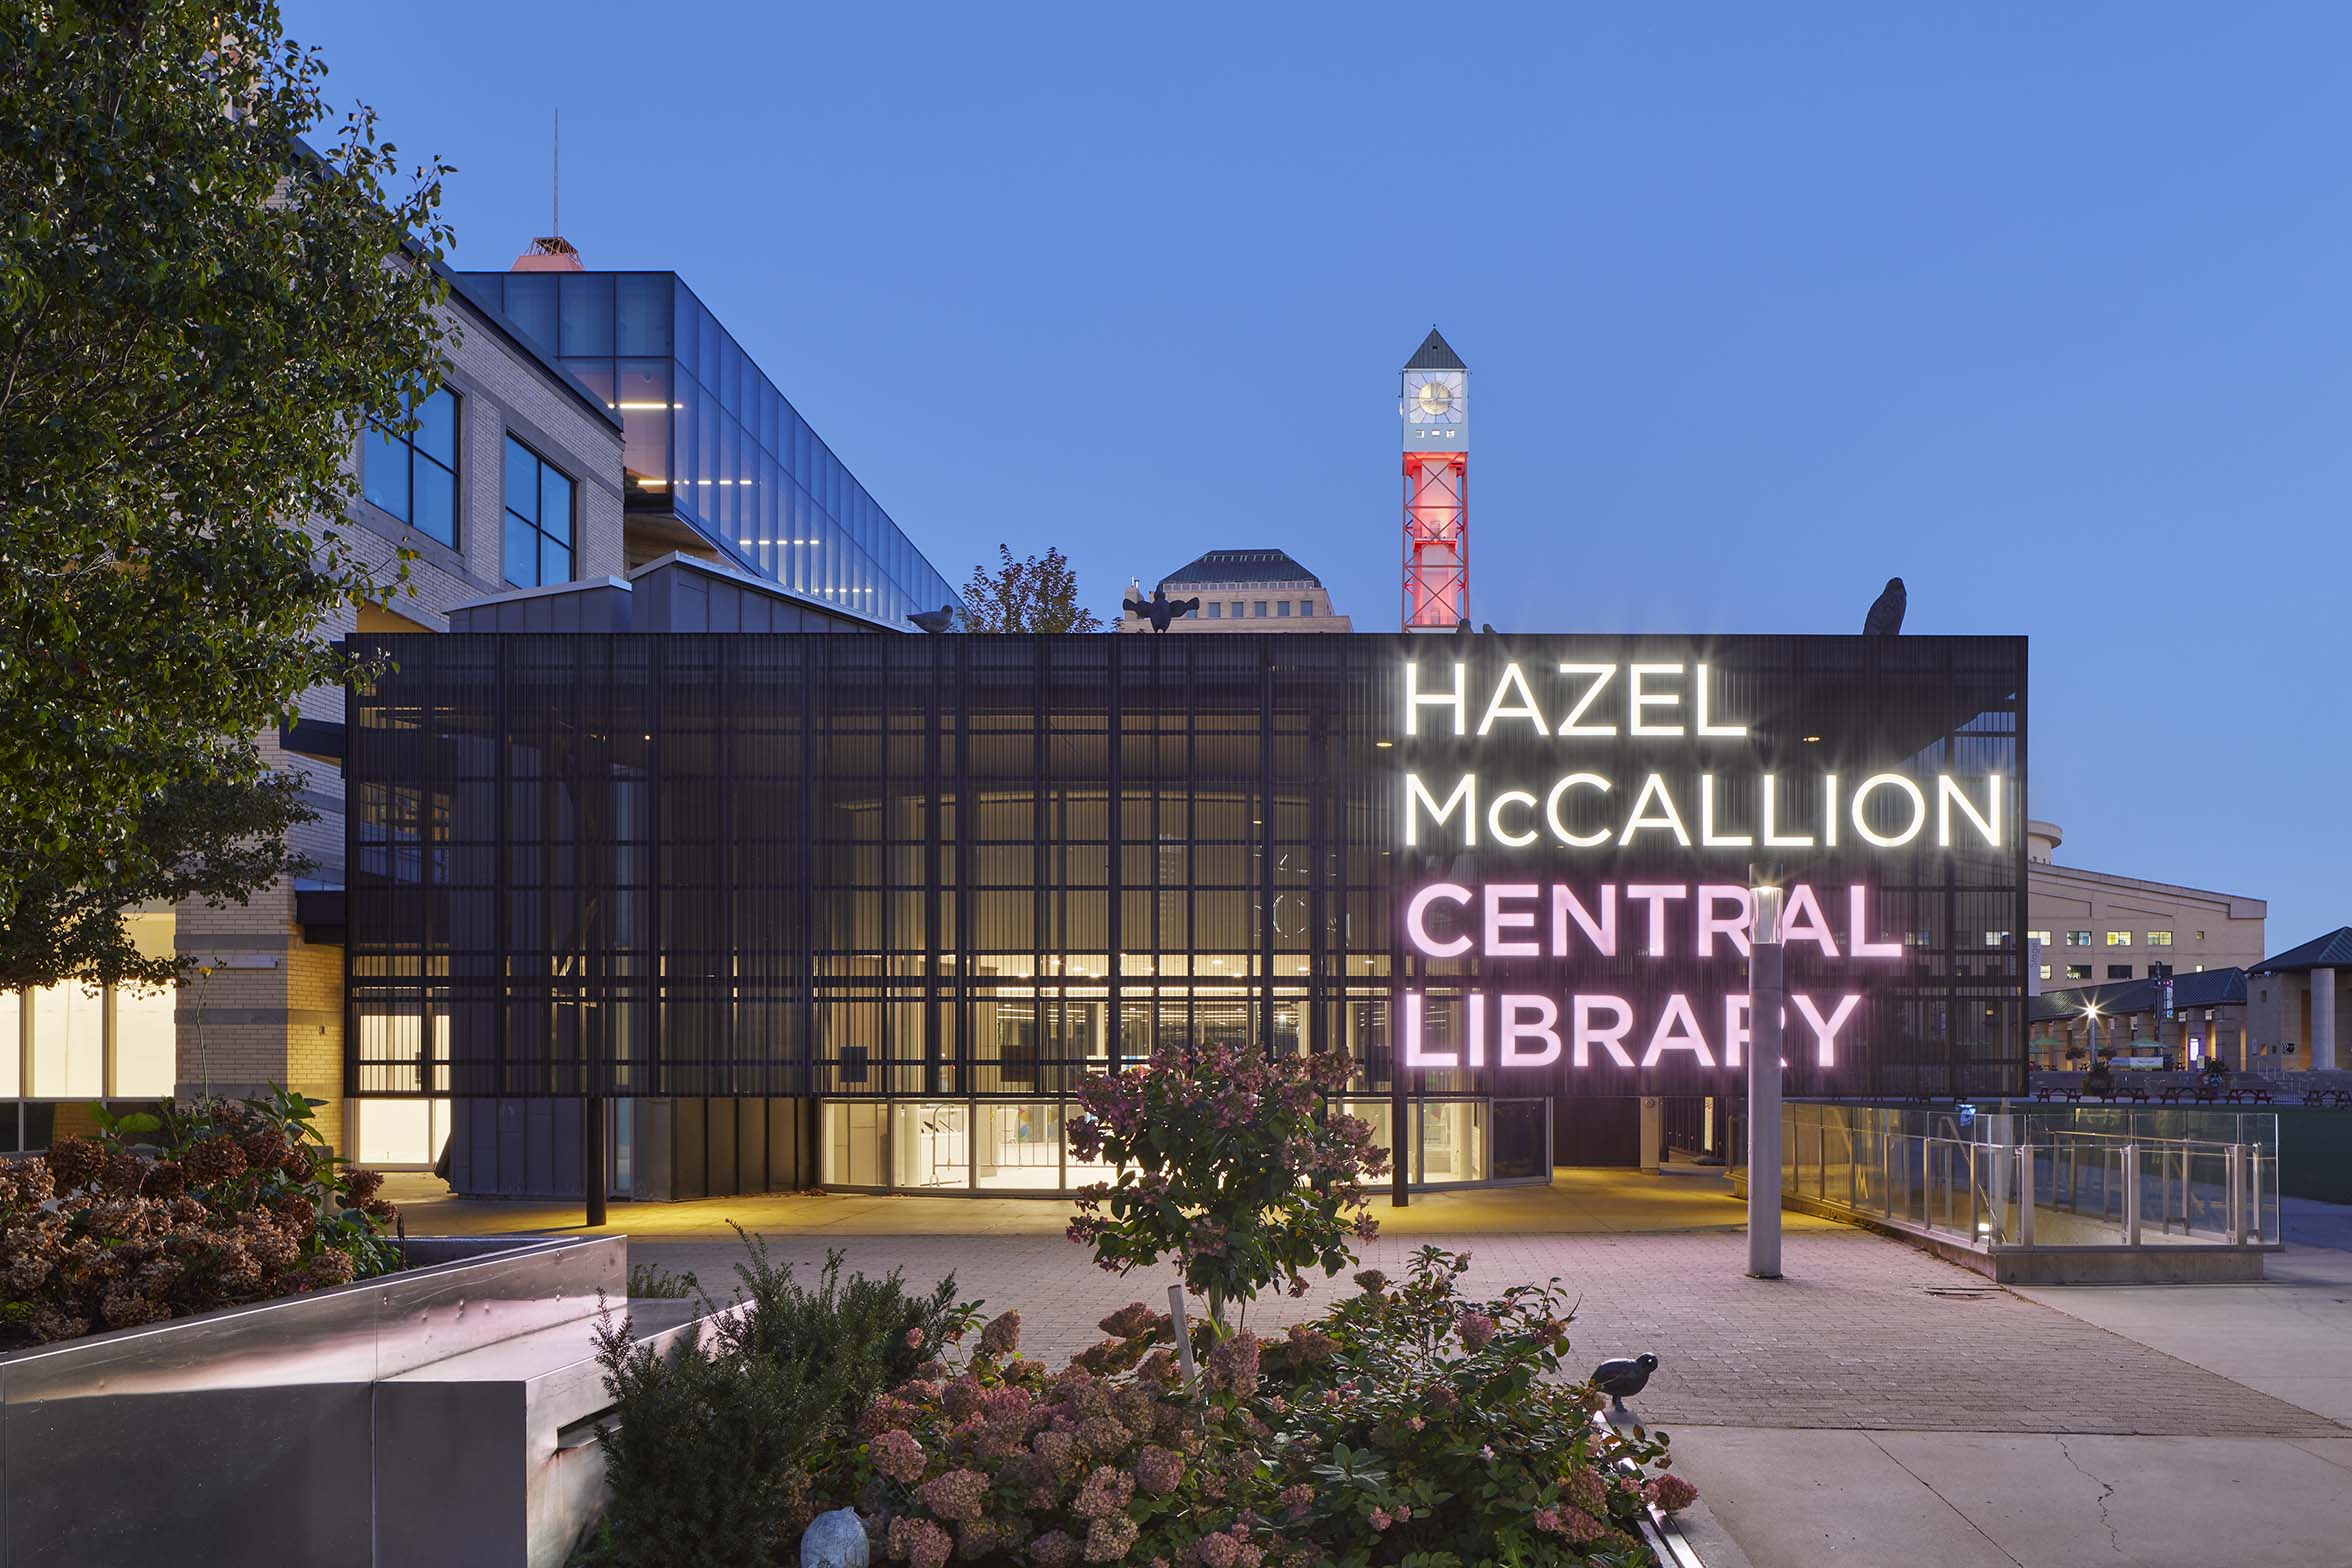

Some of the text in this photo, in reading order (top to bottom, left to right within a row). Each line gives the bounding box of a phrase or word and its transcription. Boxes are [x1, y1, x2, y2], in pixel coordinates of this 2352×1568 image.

[1406, 663, 1747, 736] HAZEL
[1406, 773, 2001, 847] McCALLION
[1406, 883, 1902, 958] CENTRAL
